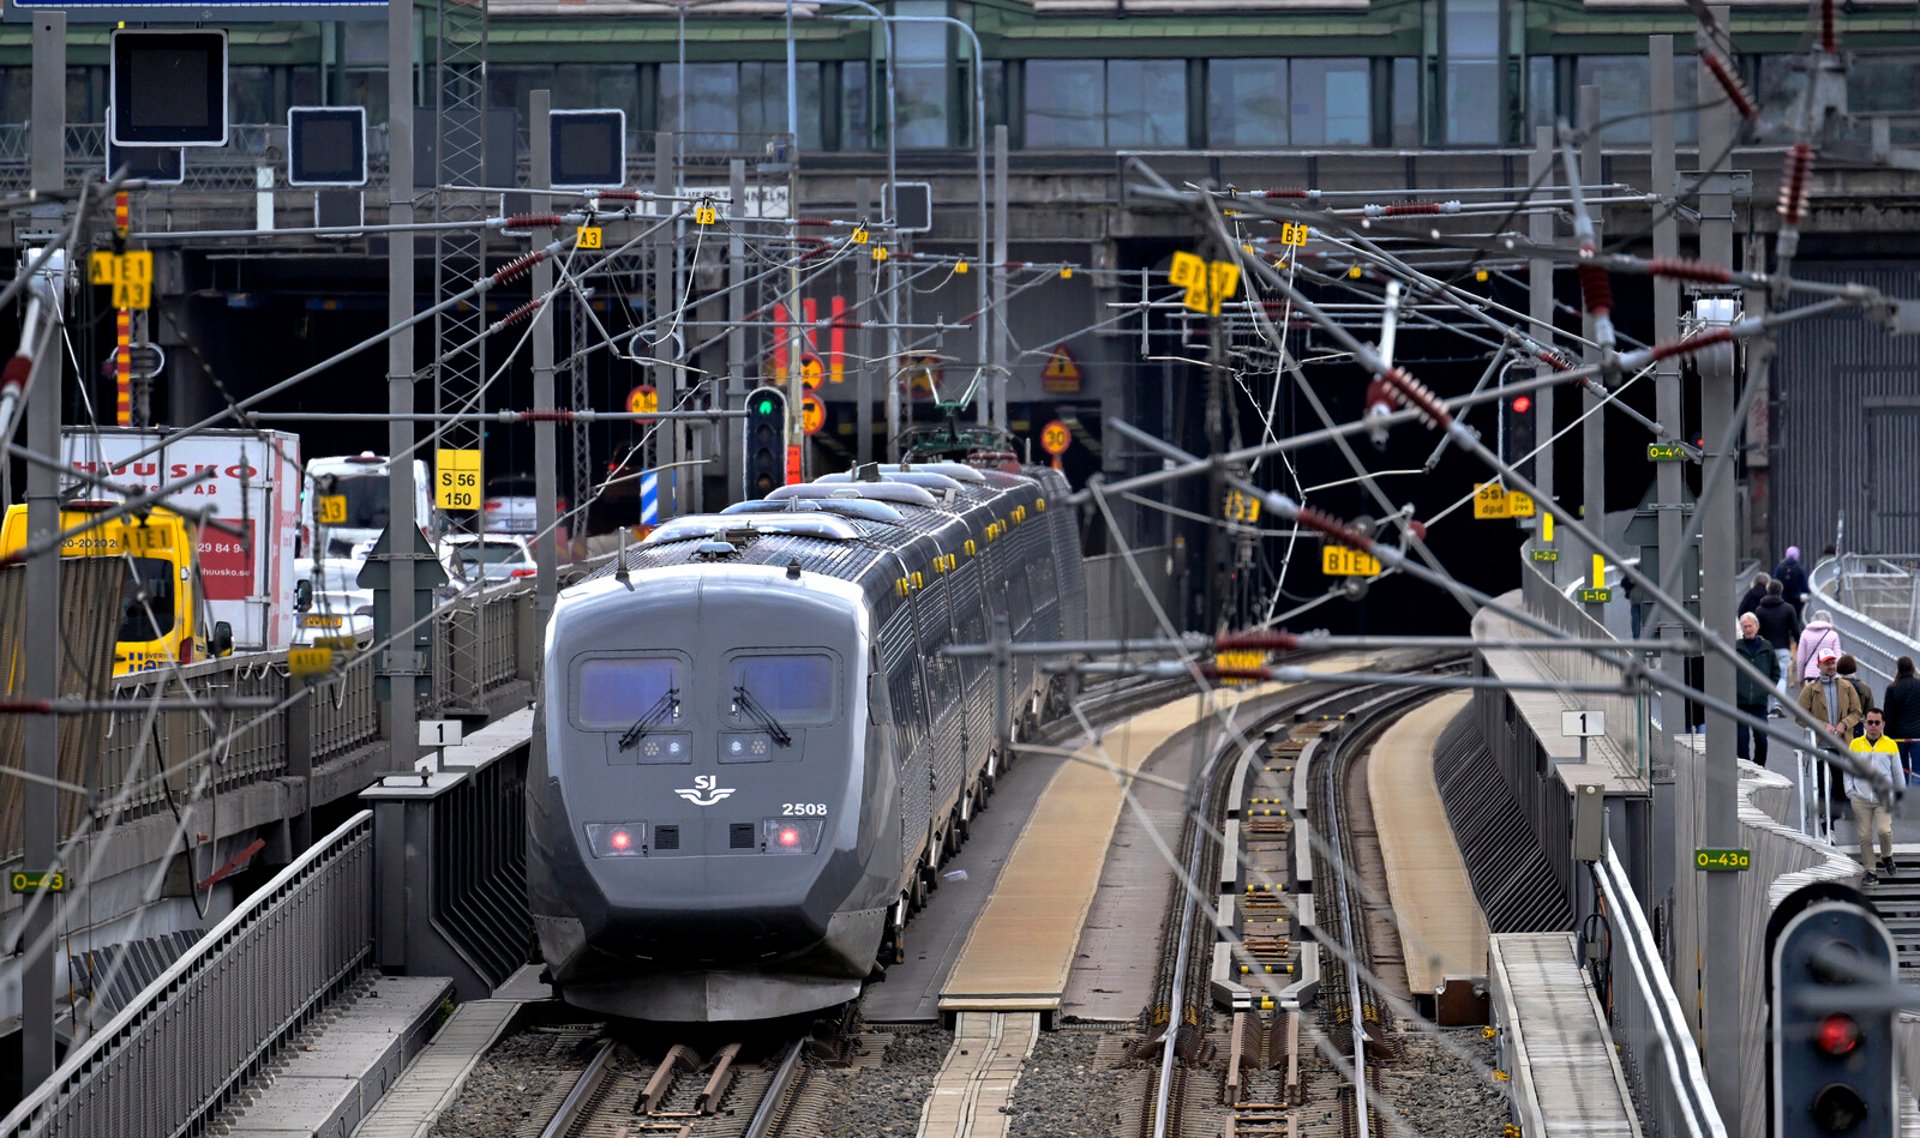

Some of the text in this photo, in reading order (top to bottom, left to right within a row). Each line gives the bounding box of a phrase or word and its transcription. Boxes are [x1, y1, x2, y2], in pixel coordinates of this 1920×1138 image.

[580, 231, 598, 246] A3
[1286, 228, 1303, 244] B3
[441, 473, 476, 487] S 56
[193, 484, 217, 495] AB
[445, 493, 472, 506] 150
[215, 543, 230, 553] 84
[1583, 590, 1608, 600] 1-1a
[1579, 712, 1588, 734] 1
[436, 722, 444, 744] 1
[694, 774, 717, 790] SJ
[781, 803, 828, 816] 2508
[1696, 852, 1749, 867] 0-43a
[13, 873, 64, 891] 0-43
